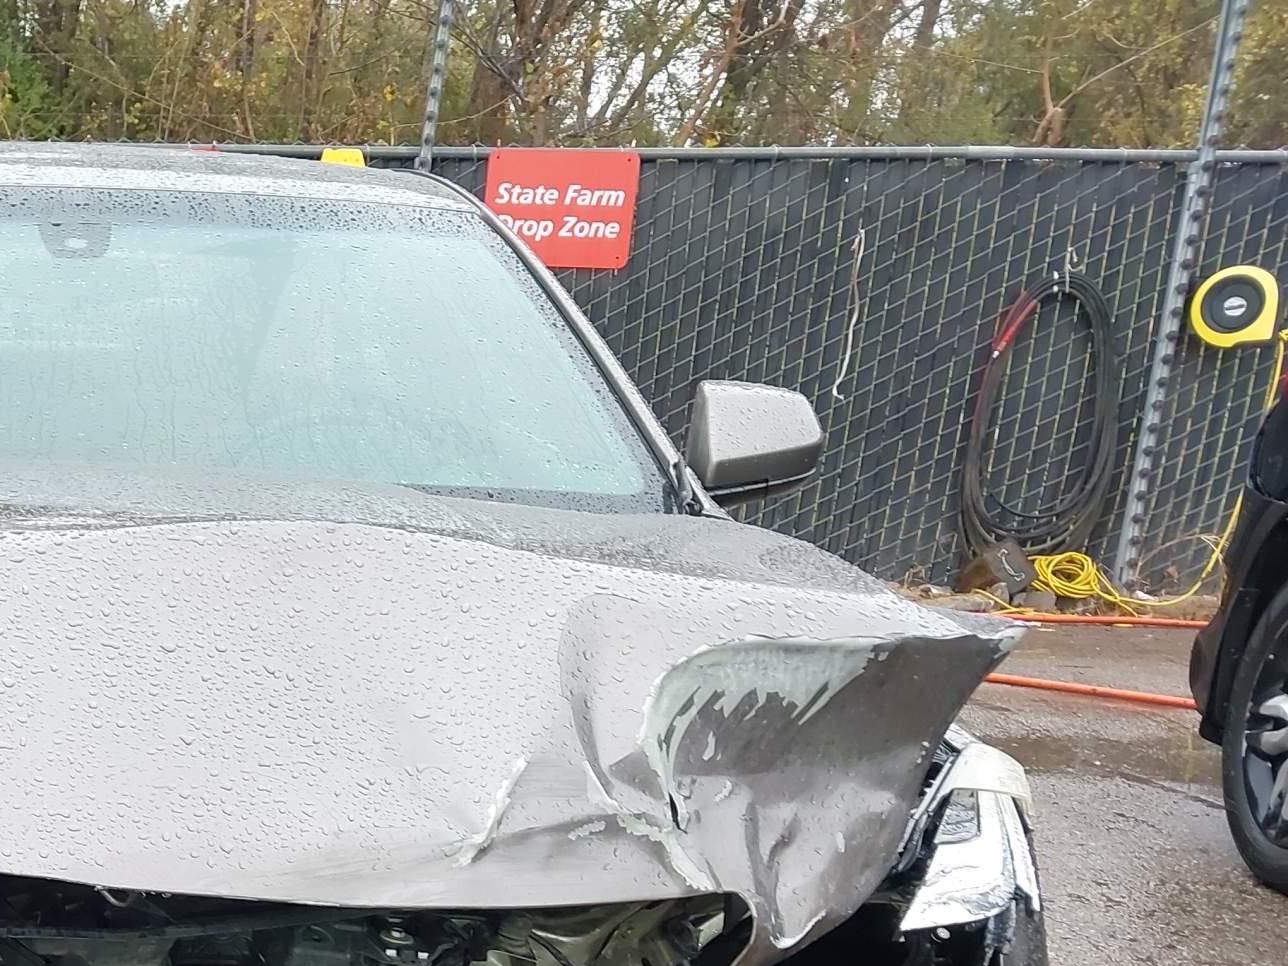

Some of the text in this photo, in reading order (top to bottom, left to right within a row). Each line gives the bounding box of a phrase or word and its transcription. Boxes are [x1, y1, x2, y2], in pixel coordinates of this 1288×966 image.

[495, 183, 625, 207] State Farm
[558, 216, 620, 238] Zone
